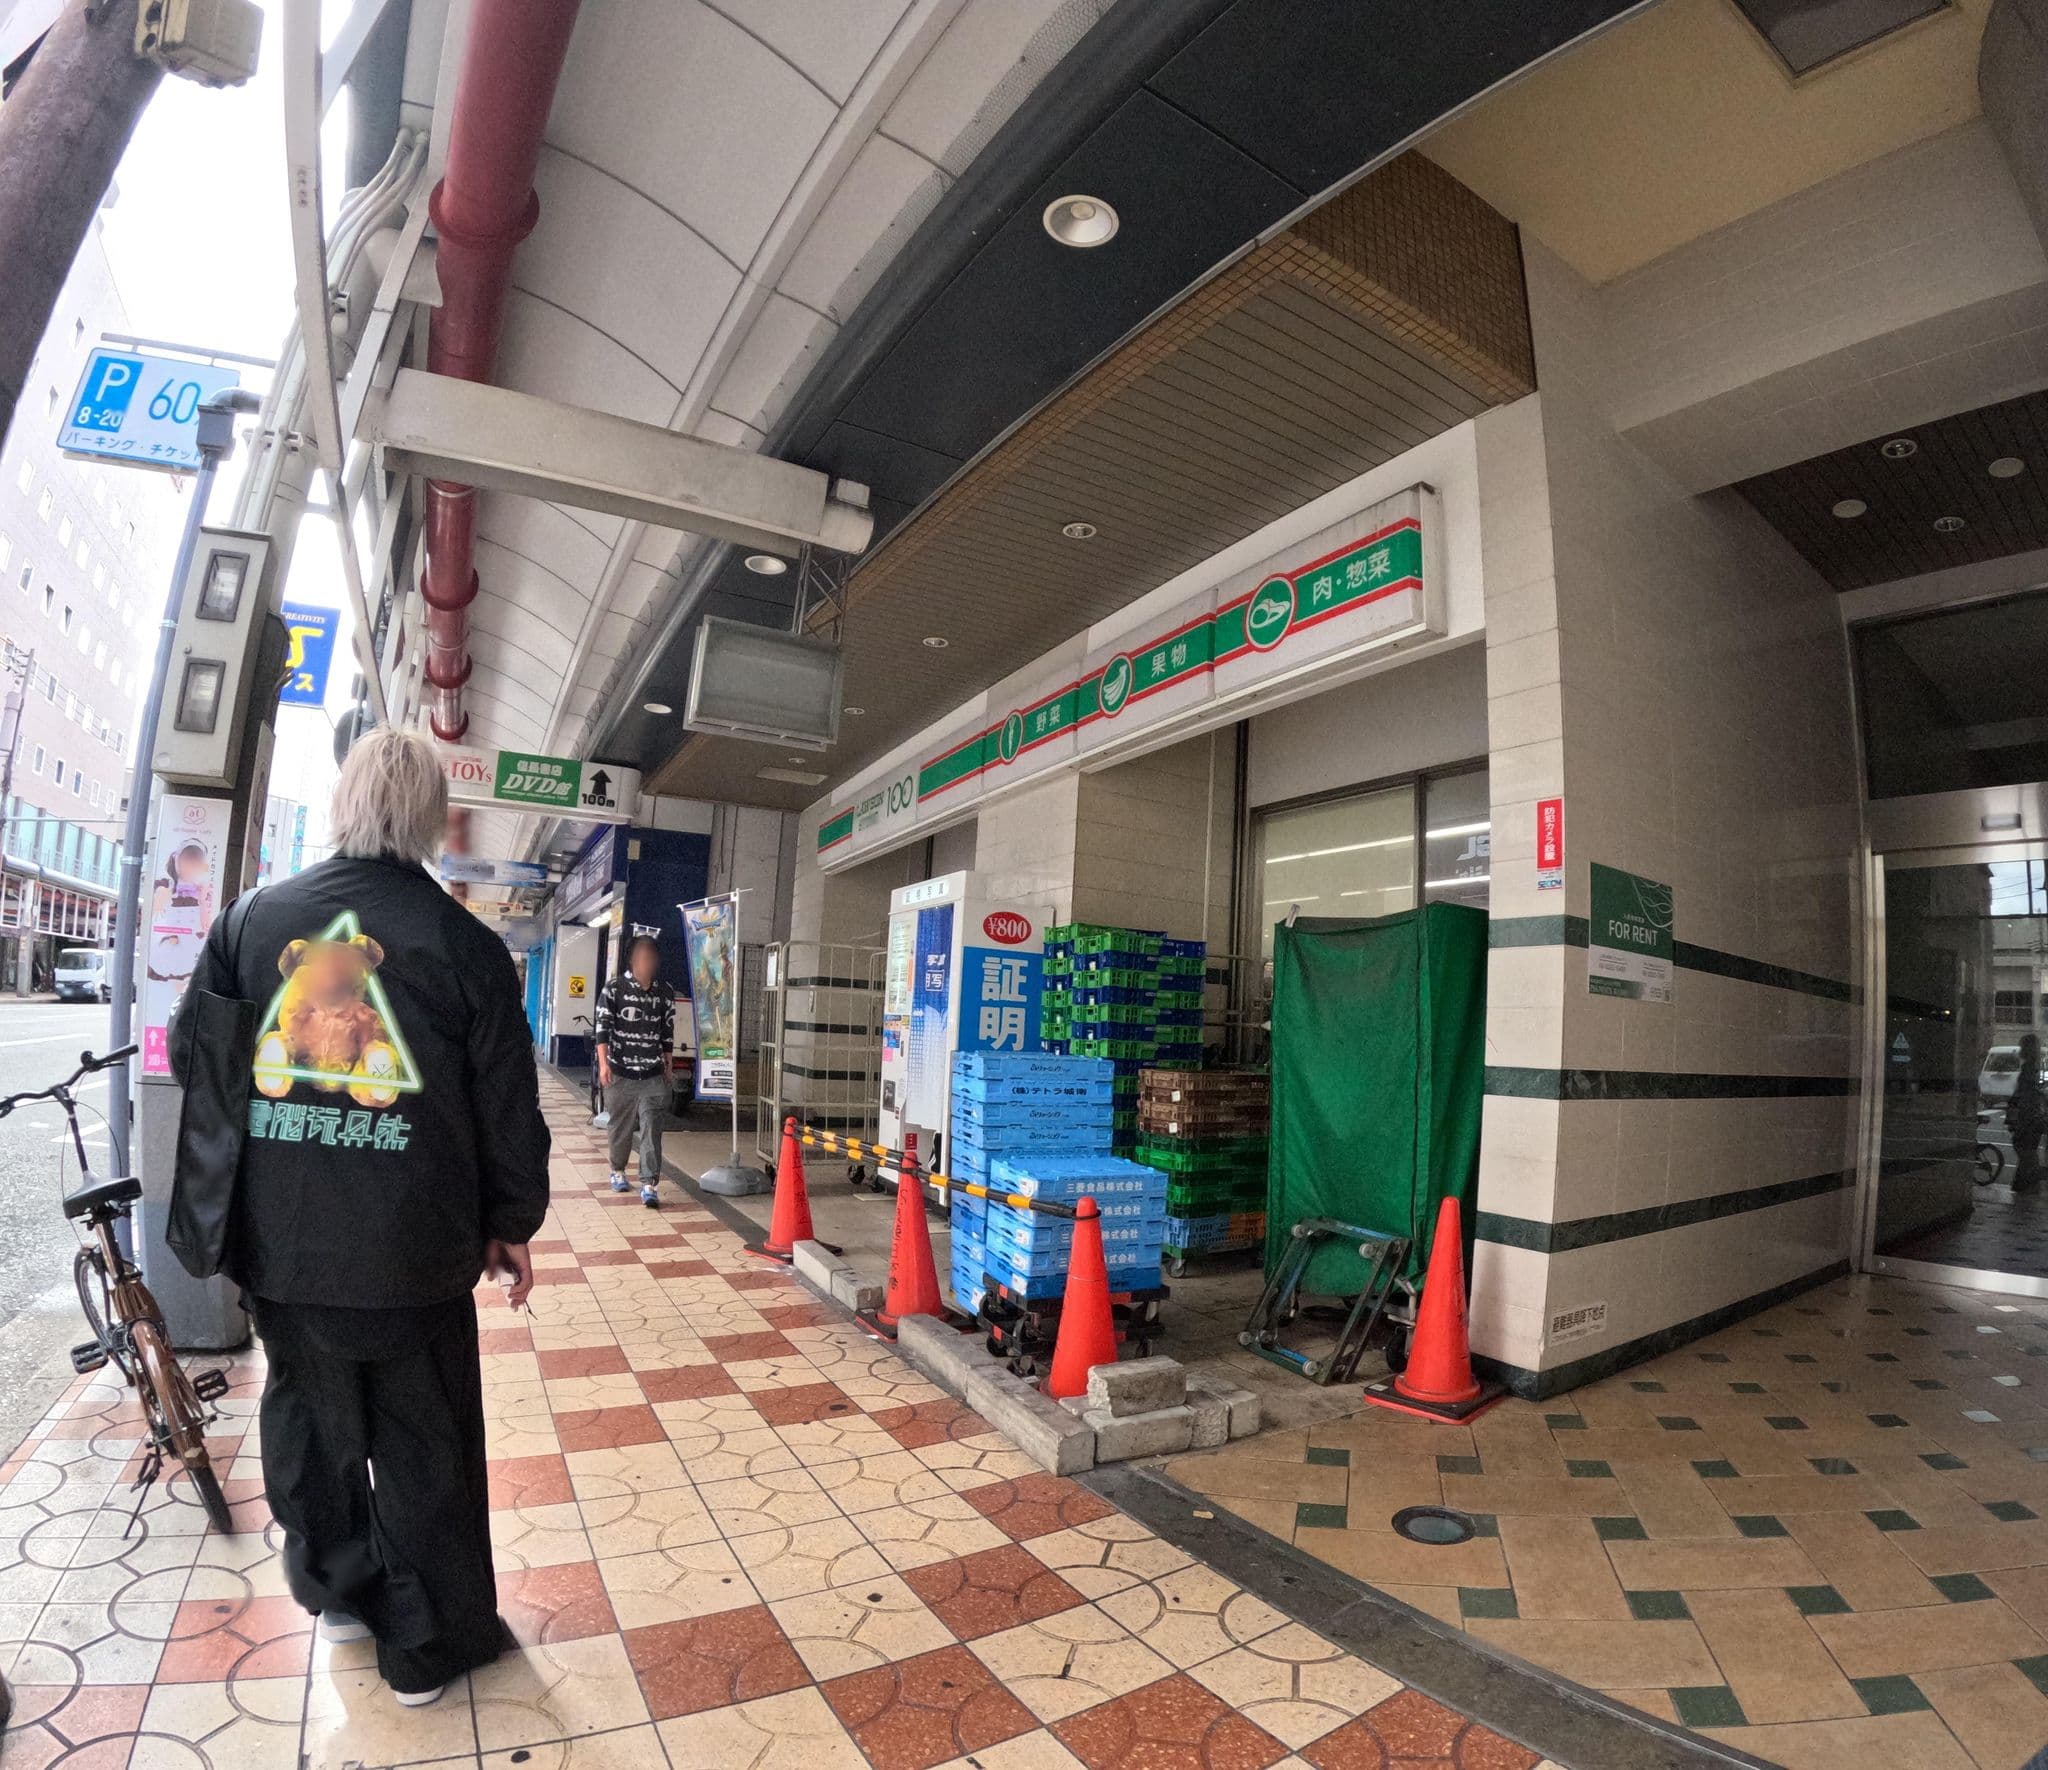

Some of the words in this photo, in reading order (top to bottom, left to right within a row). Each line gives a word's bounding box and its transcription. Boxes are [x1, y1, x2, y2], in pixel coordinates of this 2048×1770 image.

[96, 363, 131, 402] P
[1312, 548, 1392, 605] 肉・惣菜
[1151, 643, 1188, 679] 果物
[582, 793, 616, 808] 100m
[886, 775, 913, 818] 100
[988, 916, 1028, 941] ¥800
[1608, 919, 1631, 941] FOR
[1632, 925, 1659, 946] RENT
[978, 955, 1030, 1051] 証明
[1066, 1181, 1144, 1194] 三菱食品株式会社
[1098, 1204, 1142, 1217] 株式会社
